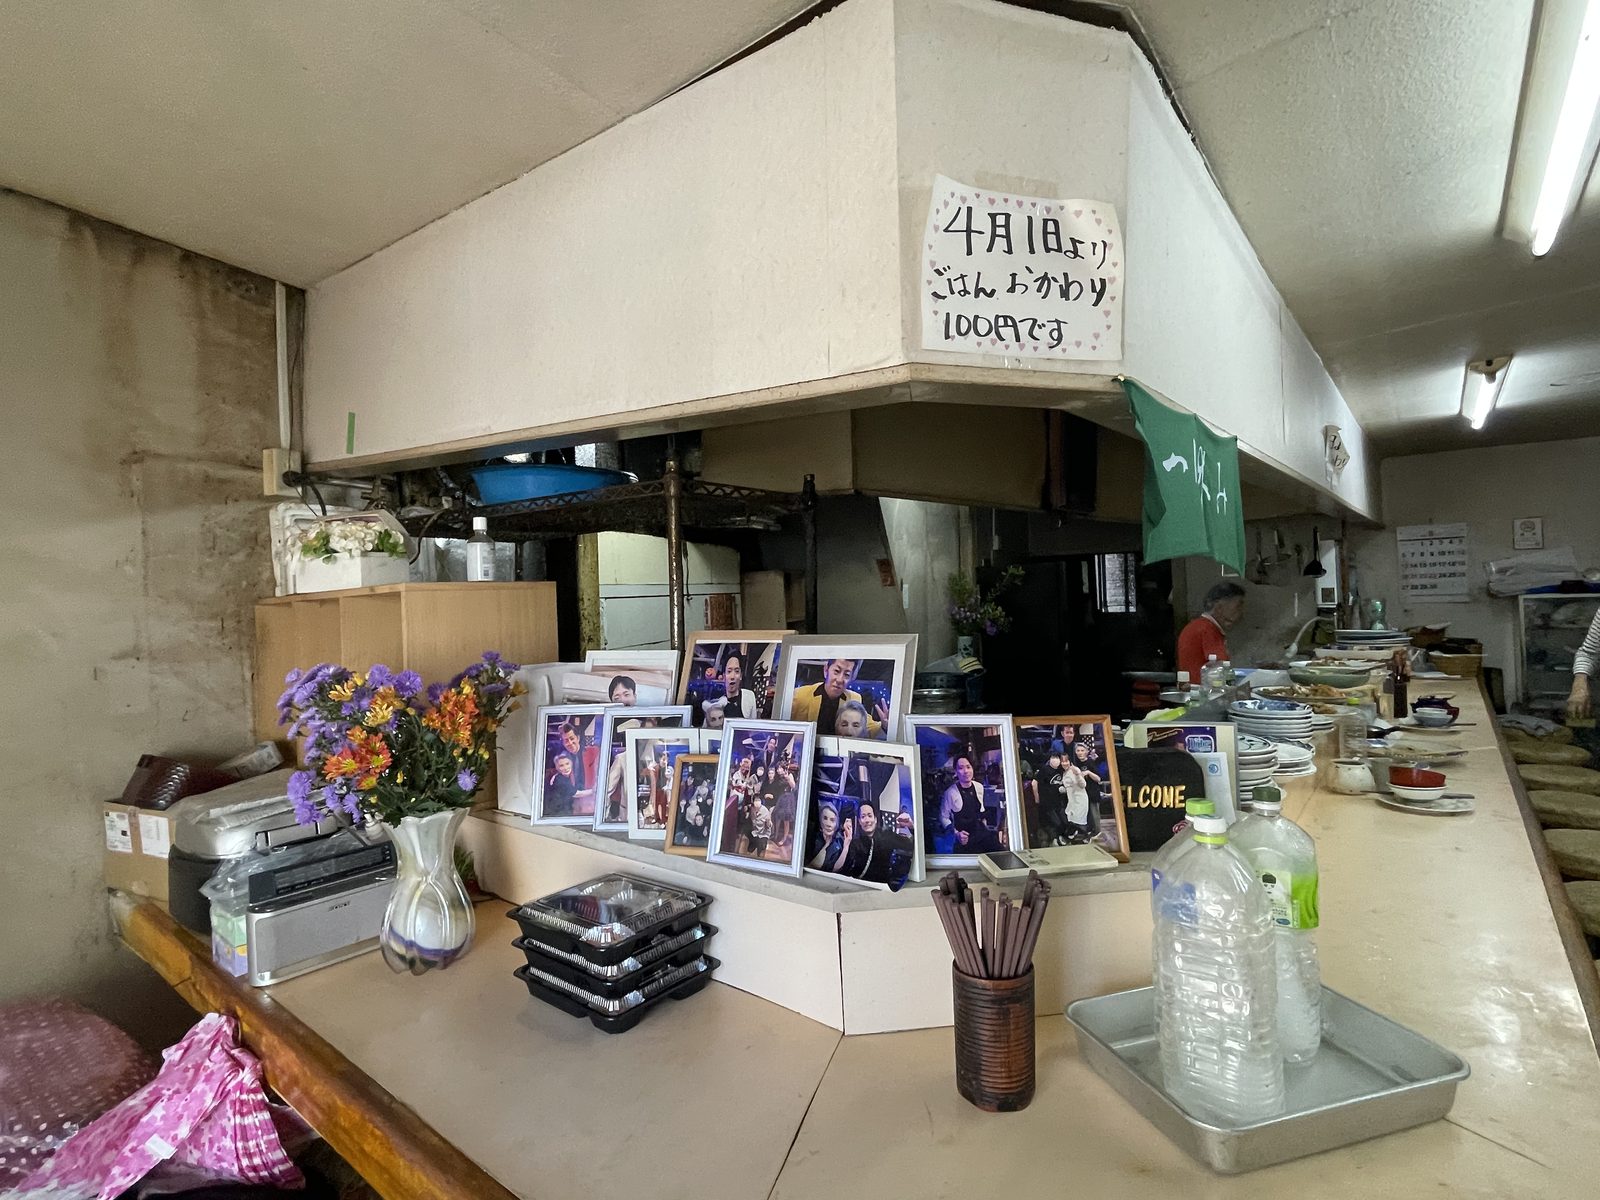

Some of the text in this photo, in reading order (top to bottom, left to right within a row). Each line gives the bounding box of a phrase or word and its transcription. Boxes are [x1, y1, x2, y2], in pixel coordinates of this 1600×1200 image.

[943, 206, 1108, 270] 4月1日より
[944, 312, 1069, 349] 100円です
